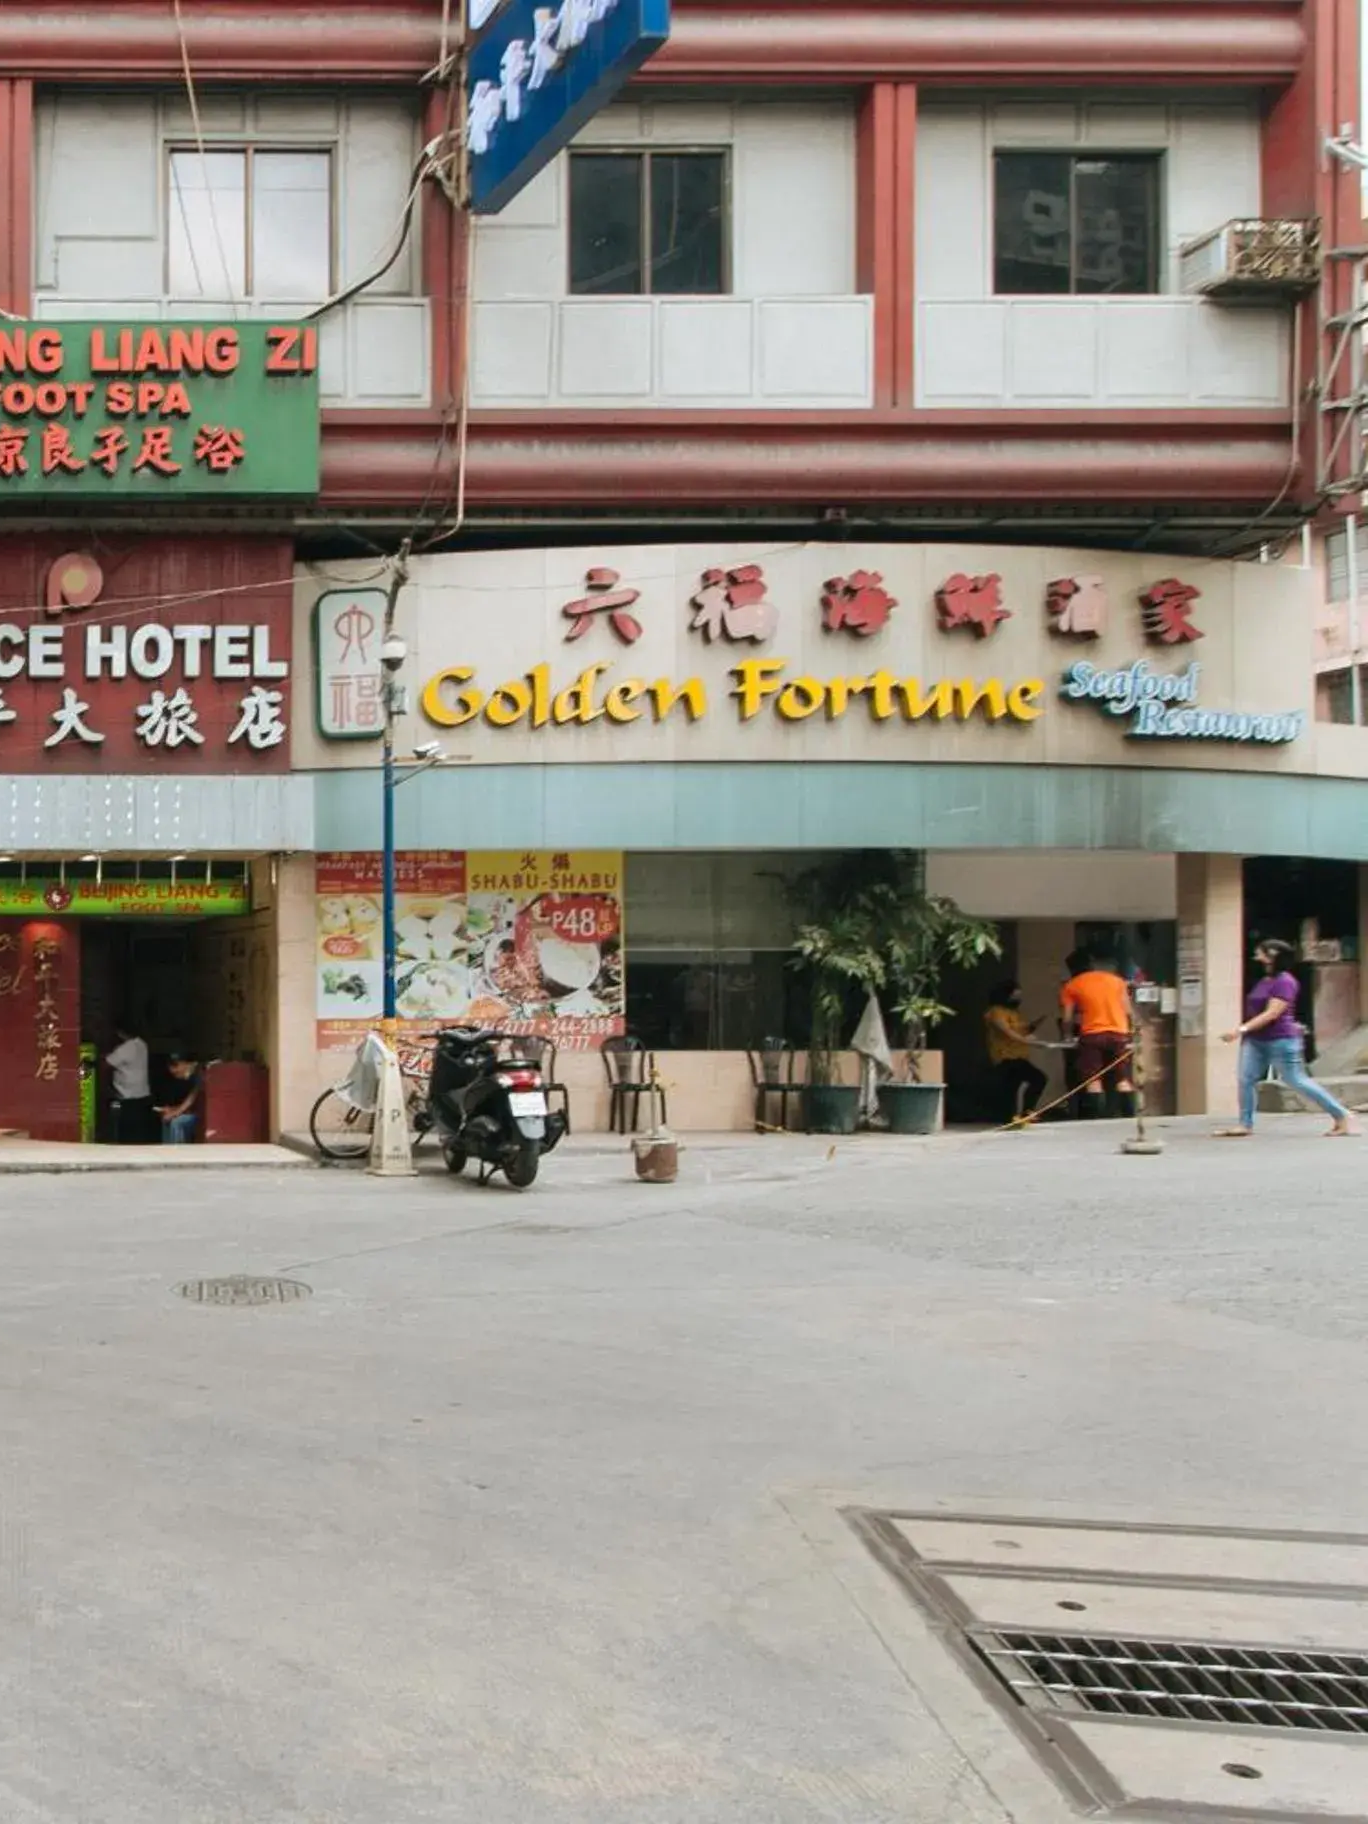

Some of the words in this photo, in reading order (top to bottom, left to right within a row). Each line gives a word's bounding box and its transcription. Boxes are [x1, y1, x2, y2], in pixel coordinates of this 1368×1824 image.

[91, 329, 241, 373] LIANG
[266, 328, 317, 373] ZI
[106, 384, 192, 415] SPA
[86, 624, 288, 678] HOTEL
[422, 659, 708, 729] Golden
[730, 657, 1046, 721] Fortune
[1065, 659, 1201, 714] Seafood
[470, 873, 618, 890] SHABU-SHABU
